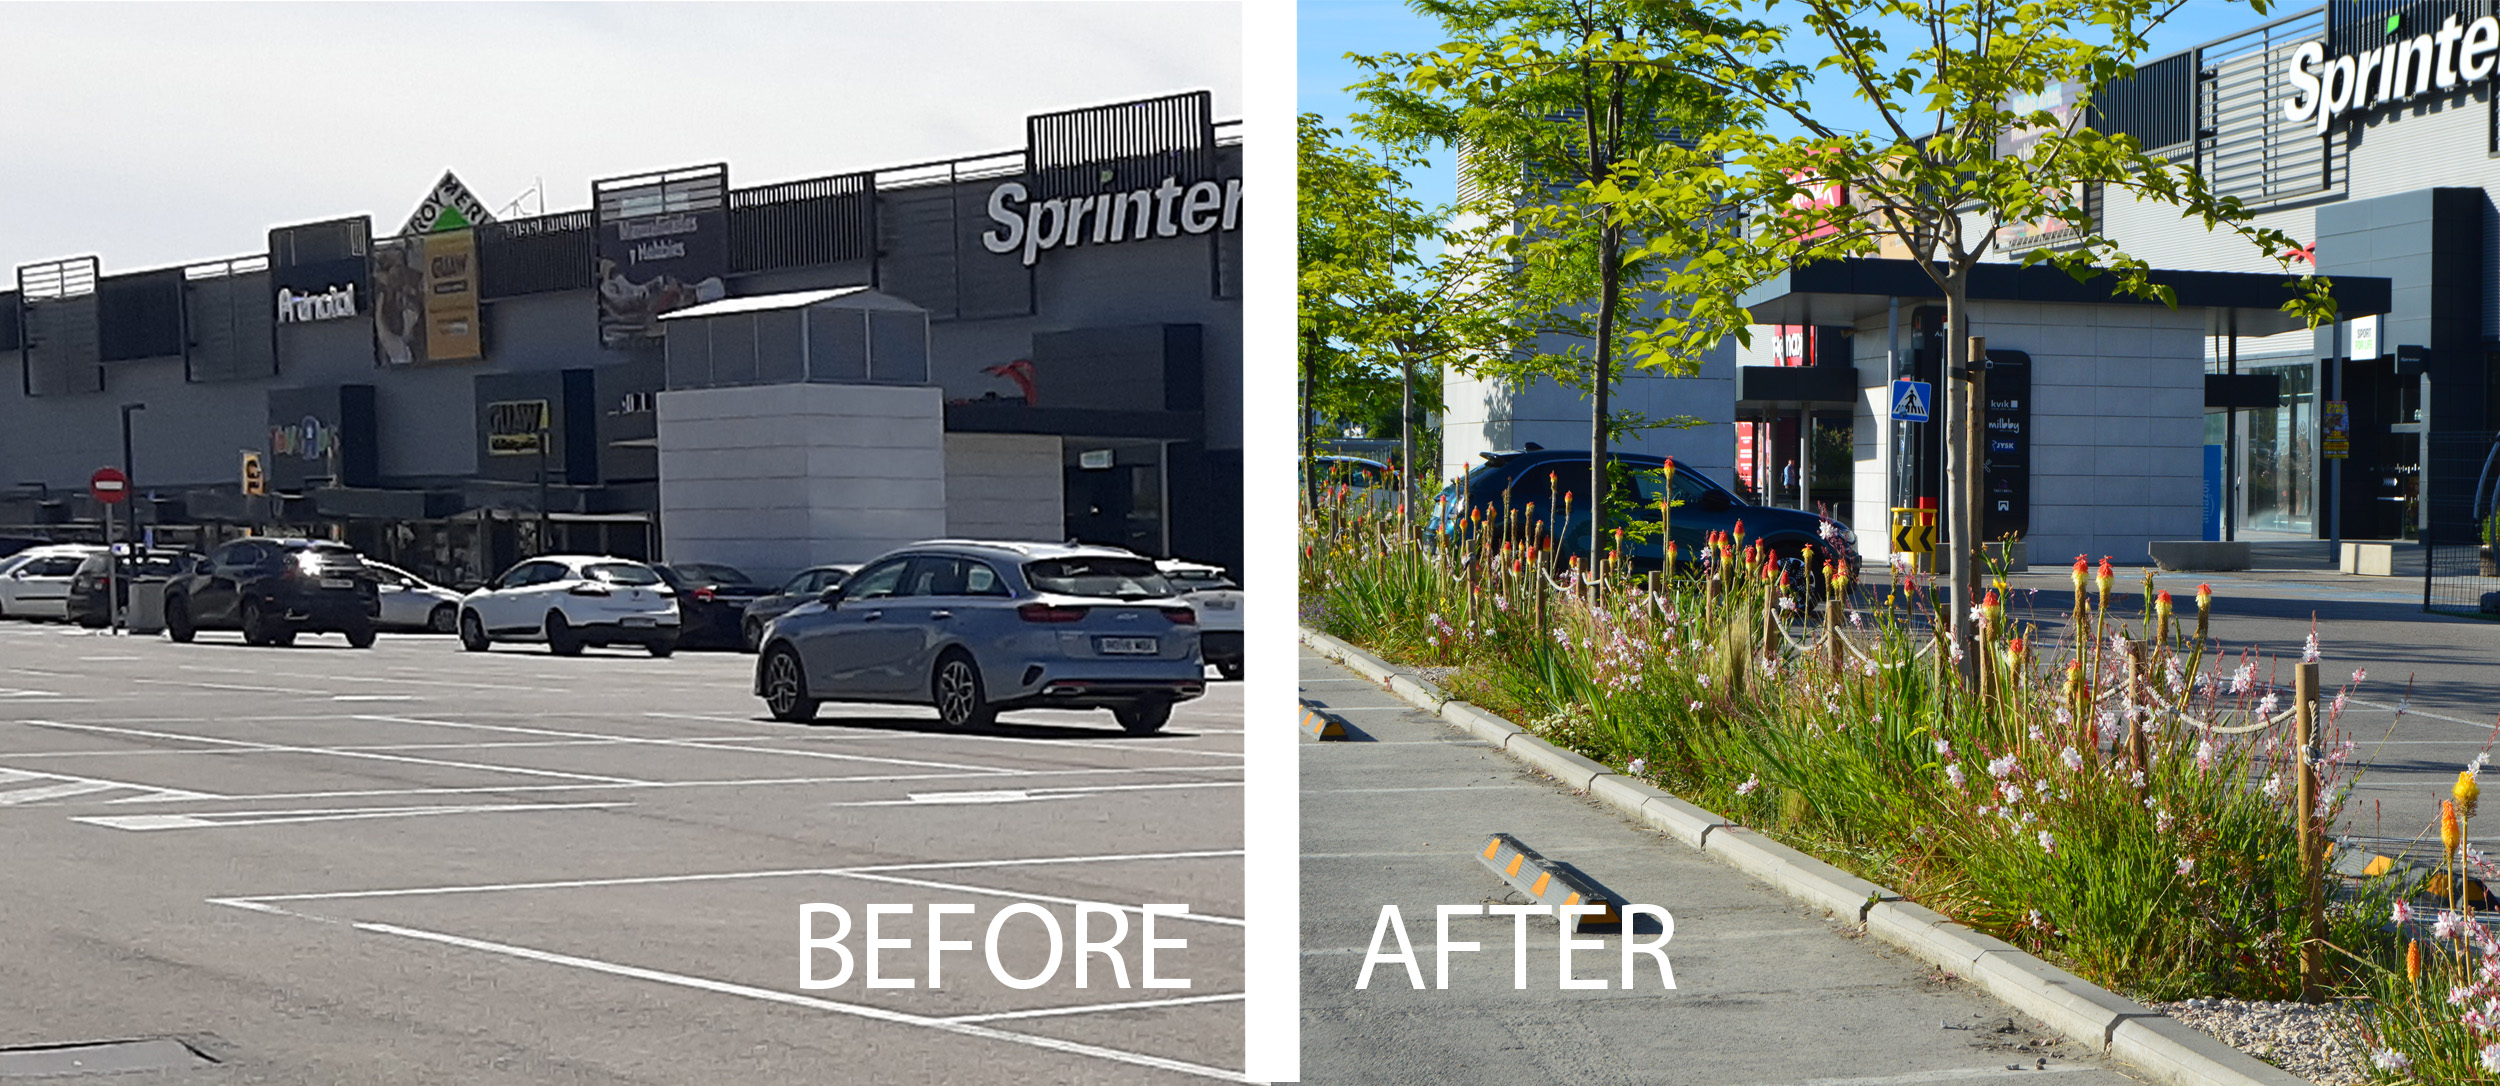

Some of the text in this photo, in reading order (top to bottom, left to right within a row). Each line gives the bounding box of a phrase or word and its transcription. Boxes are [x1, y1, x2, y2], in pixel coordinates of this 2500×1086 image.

[2283, 14, 2500, 136] Sprinte
[982, 171, 1243, 266] Sprinter
[2357, 327, 2372, 339] SPORT
[2355, 339, 2373, 351] FOR LIFE
[1991, 400, 2009, 408] kvik
[1989, 418, 2020, 433] milbby
